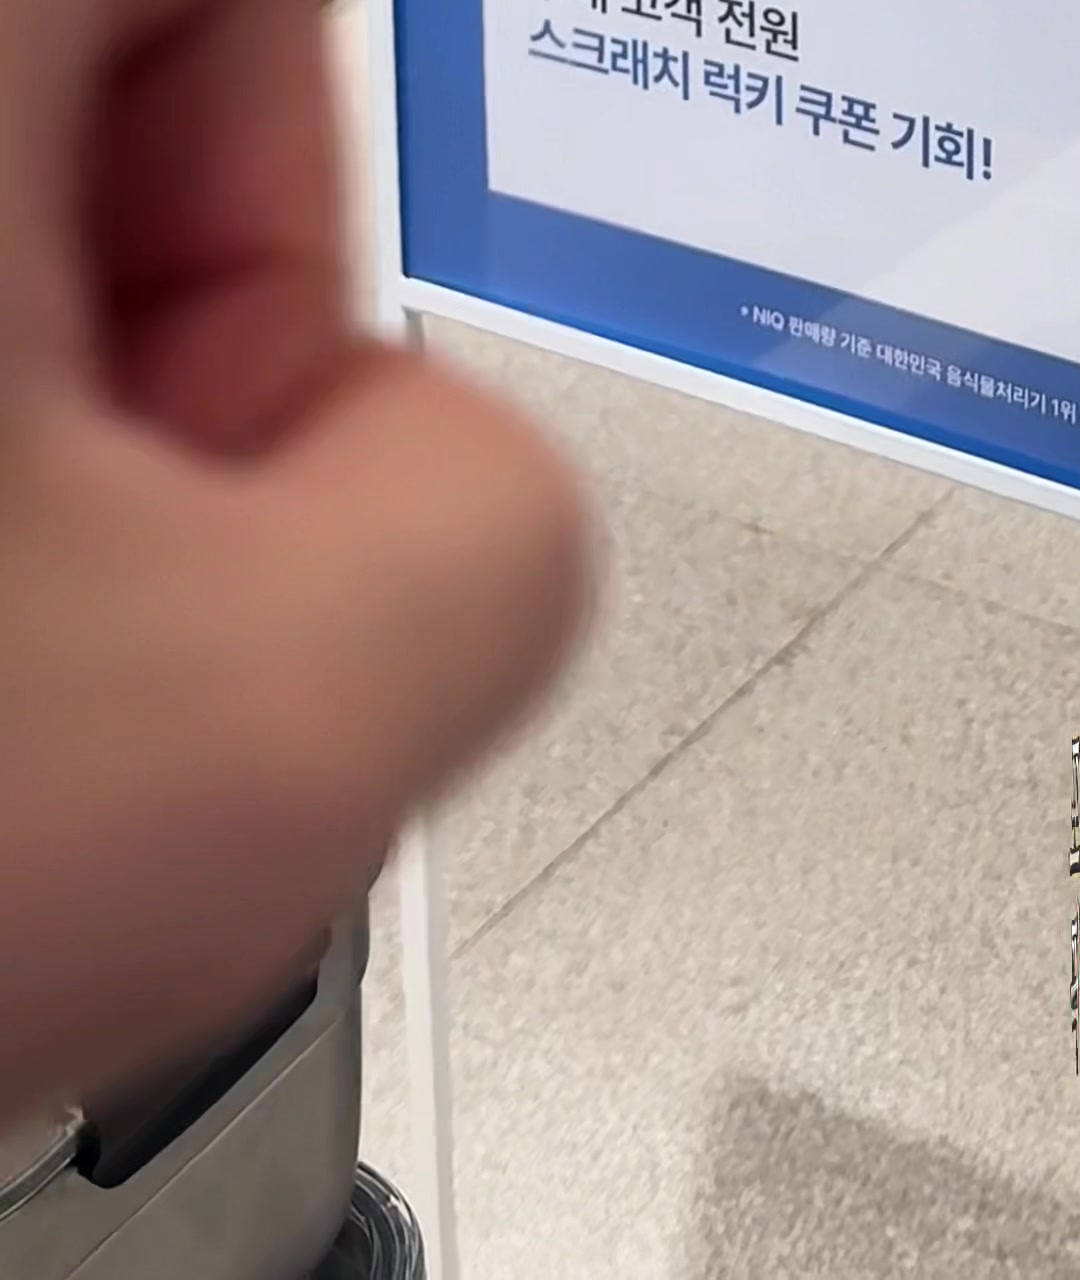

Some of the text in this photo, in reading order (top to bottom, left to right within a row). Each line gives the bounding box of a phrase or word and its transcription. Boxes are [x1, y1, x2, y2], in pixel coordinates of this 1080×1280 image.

[528, 17, 993, 181] 스크래치 럭키 쿠폰 기회!
[788, 315, 837, 349] 판매량
[840, 331, 873, 359] 기준
[876, 343, 941, 381] 대한민국
[947, 364, 1047, 415] 음식물처리기
[1051, 397, 1077, 425] 1위
